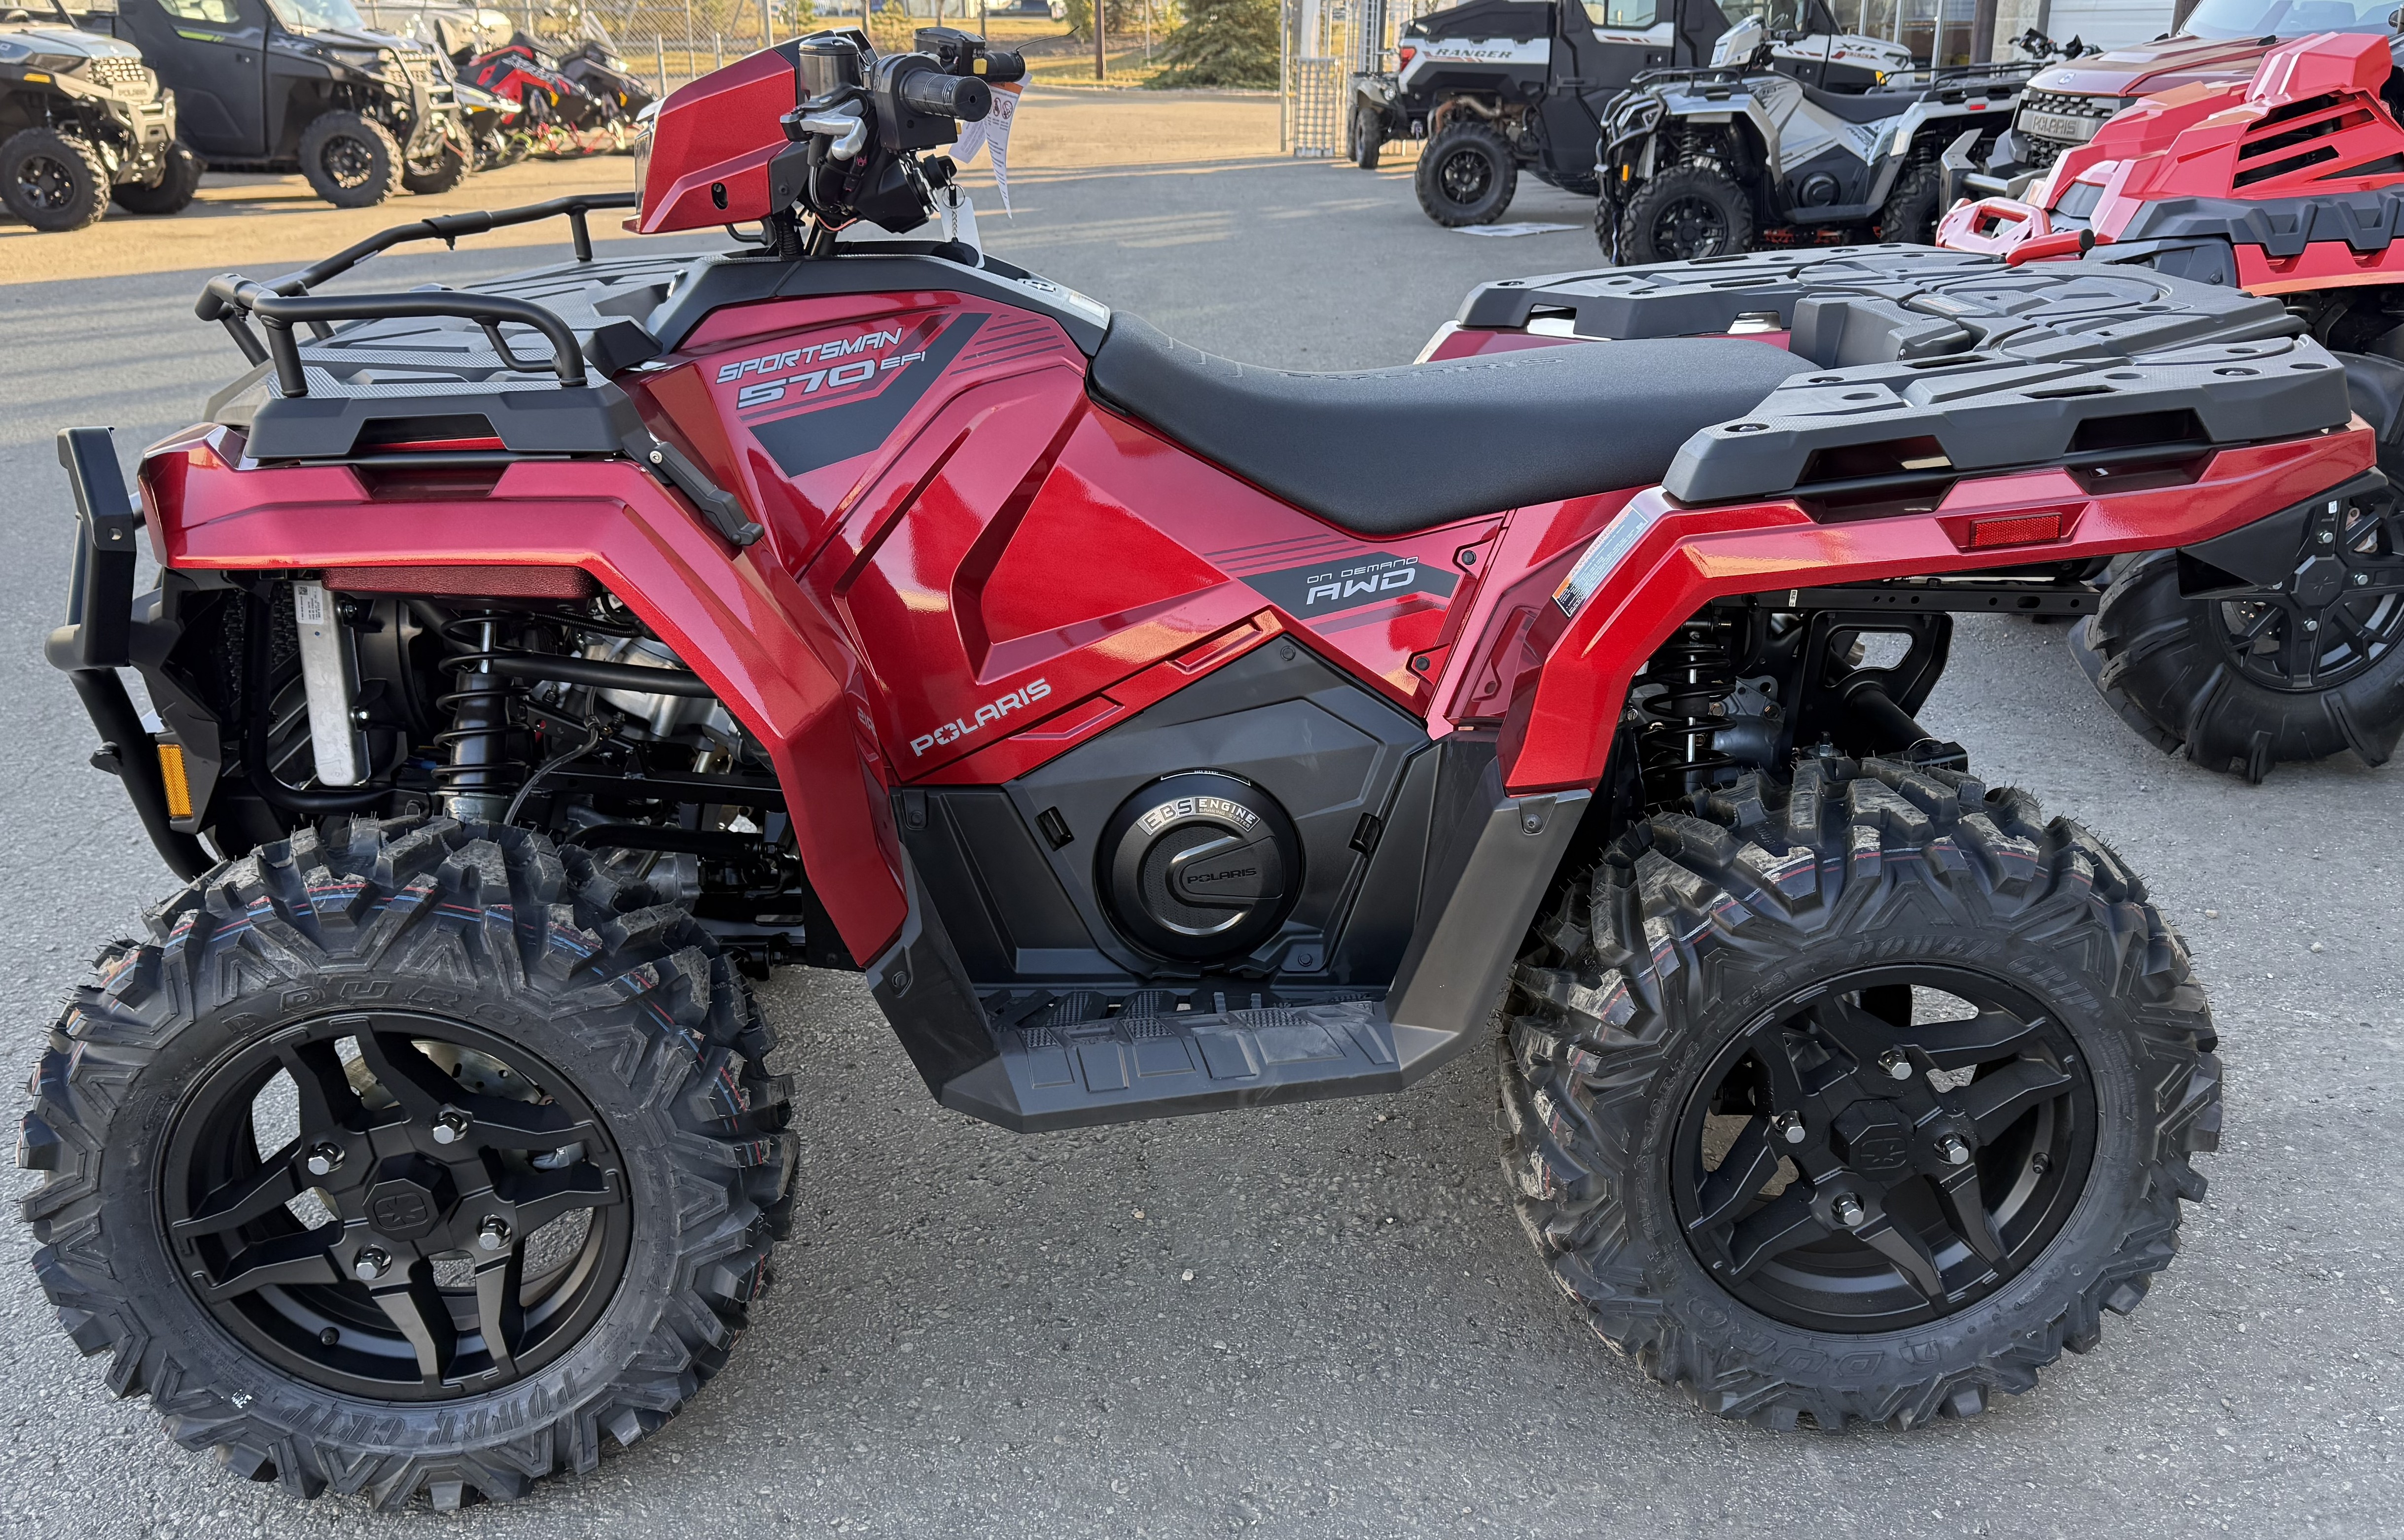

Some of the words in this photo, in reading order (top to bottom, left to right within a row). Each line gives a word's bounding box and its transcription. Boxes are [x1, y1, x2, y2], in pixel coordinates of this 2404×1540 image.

[1435, 48, 1513, 58] RANGER
[2033, 115, 2077, 136] POLARIS
[715, 327, 903, 385] SPORTSMAN
[737, 358, 877, 410] 570
[880, 350, 926, 371] EFI
[1306, 567, 1416, 605] AWD
[1307, 573, 1332, 584] ON
[1341, 556, 1419, 579] DEMAND
[909, 678, 1052, 757] POLARIS
[1144, 799, 1192, 832] EBS
[1198, 799, 1257, 825] ENGINE
[1187, 867, 1257, 884] POLARIS
[1845, 934, 2002, 965] POWER
[2006, 955, 2100, 1010] GRIP
[279, 980, 521, 1026] DURO
[1687, 1295, 1884, 1377] DURO
[278, 1401, 405, 1445] GRIP
[426, 1366, 579, 1445] POWER
